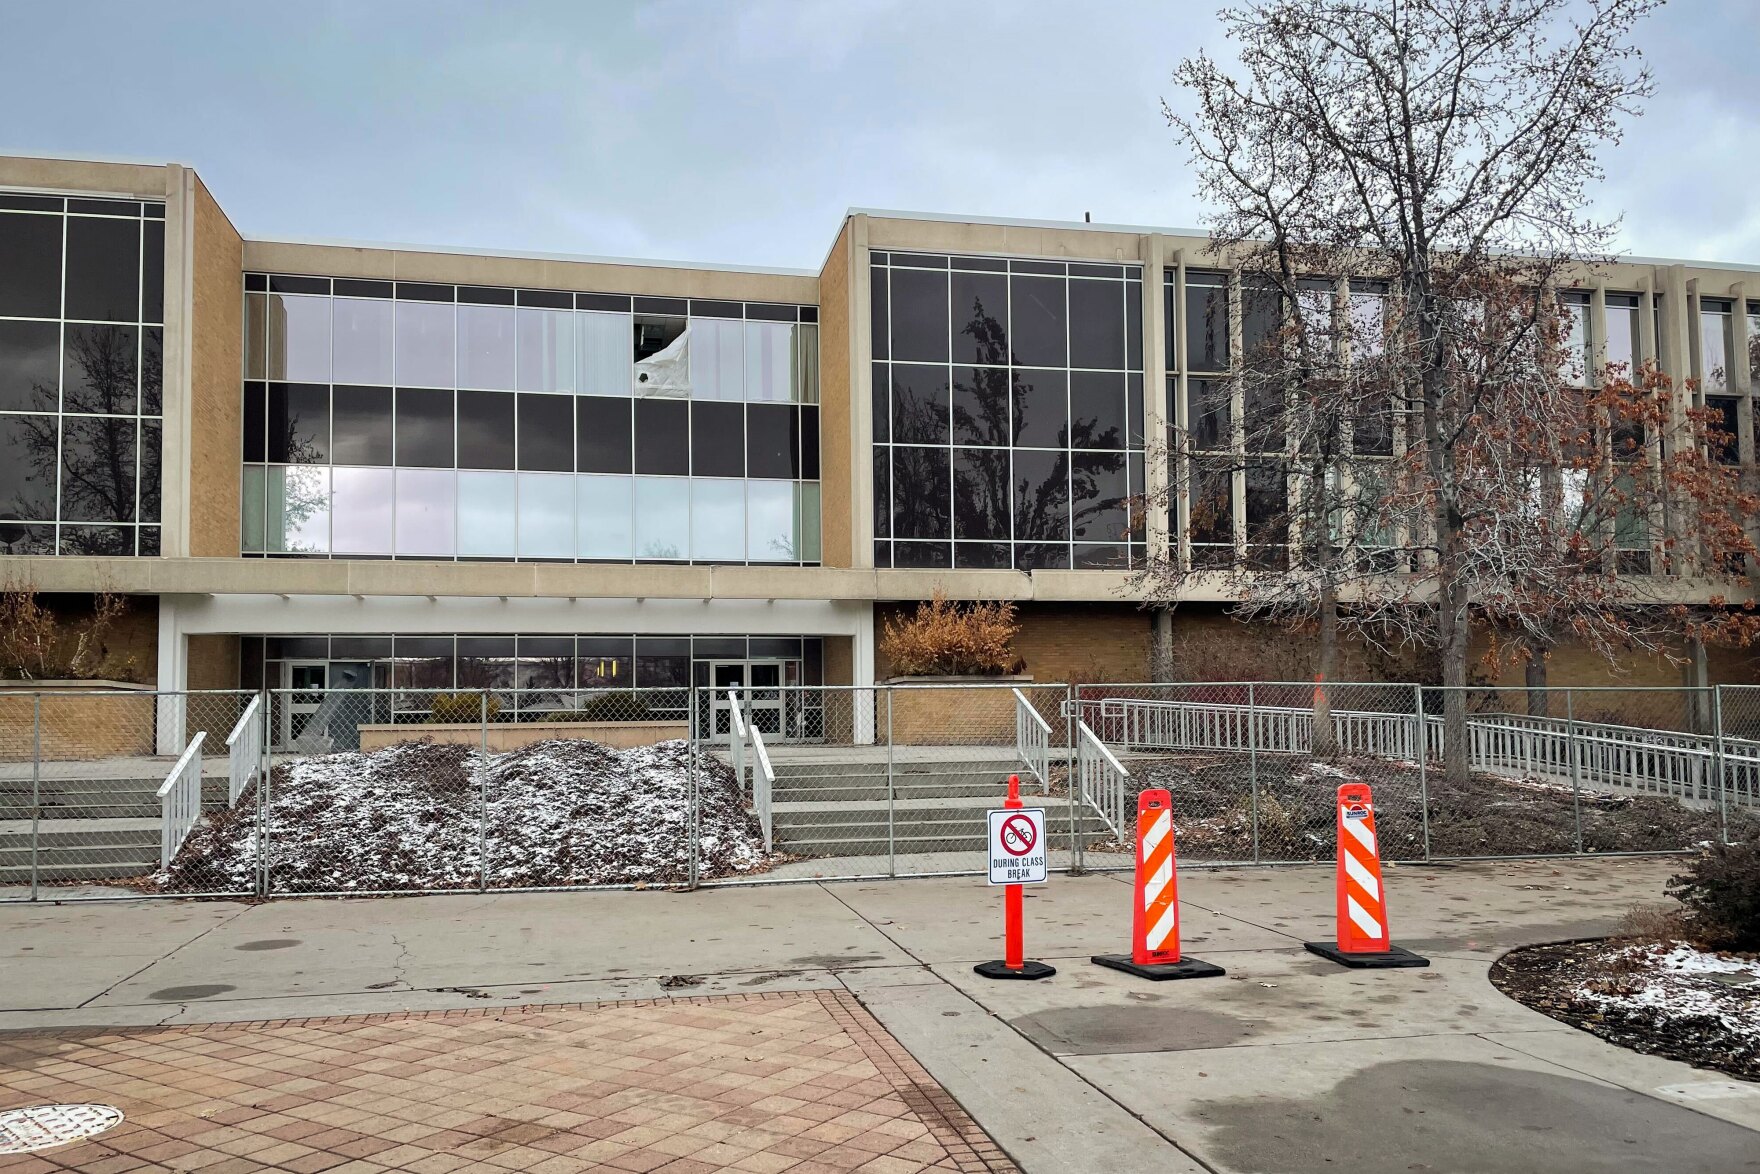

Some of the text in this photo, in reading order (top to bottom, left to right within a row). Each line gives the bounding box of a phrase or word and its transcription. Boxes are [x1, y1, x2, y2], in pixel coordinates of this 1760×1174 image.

[993, 856, 1043, 868] DURING CLASS
[1008, 868, 1030, 879] BREAK
